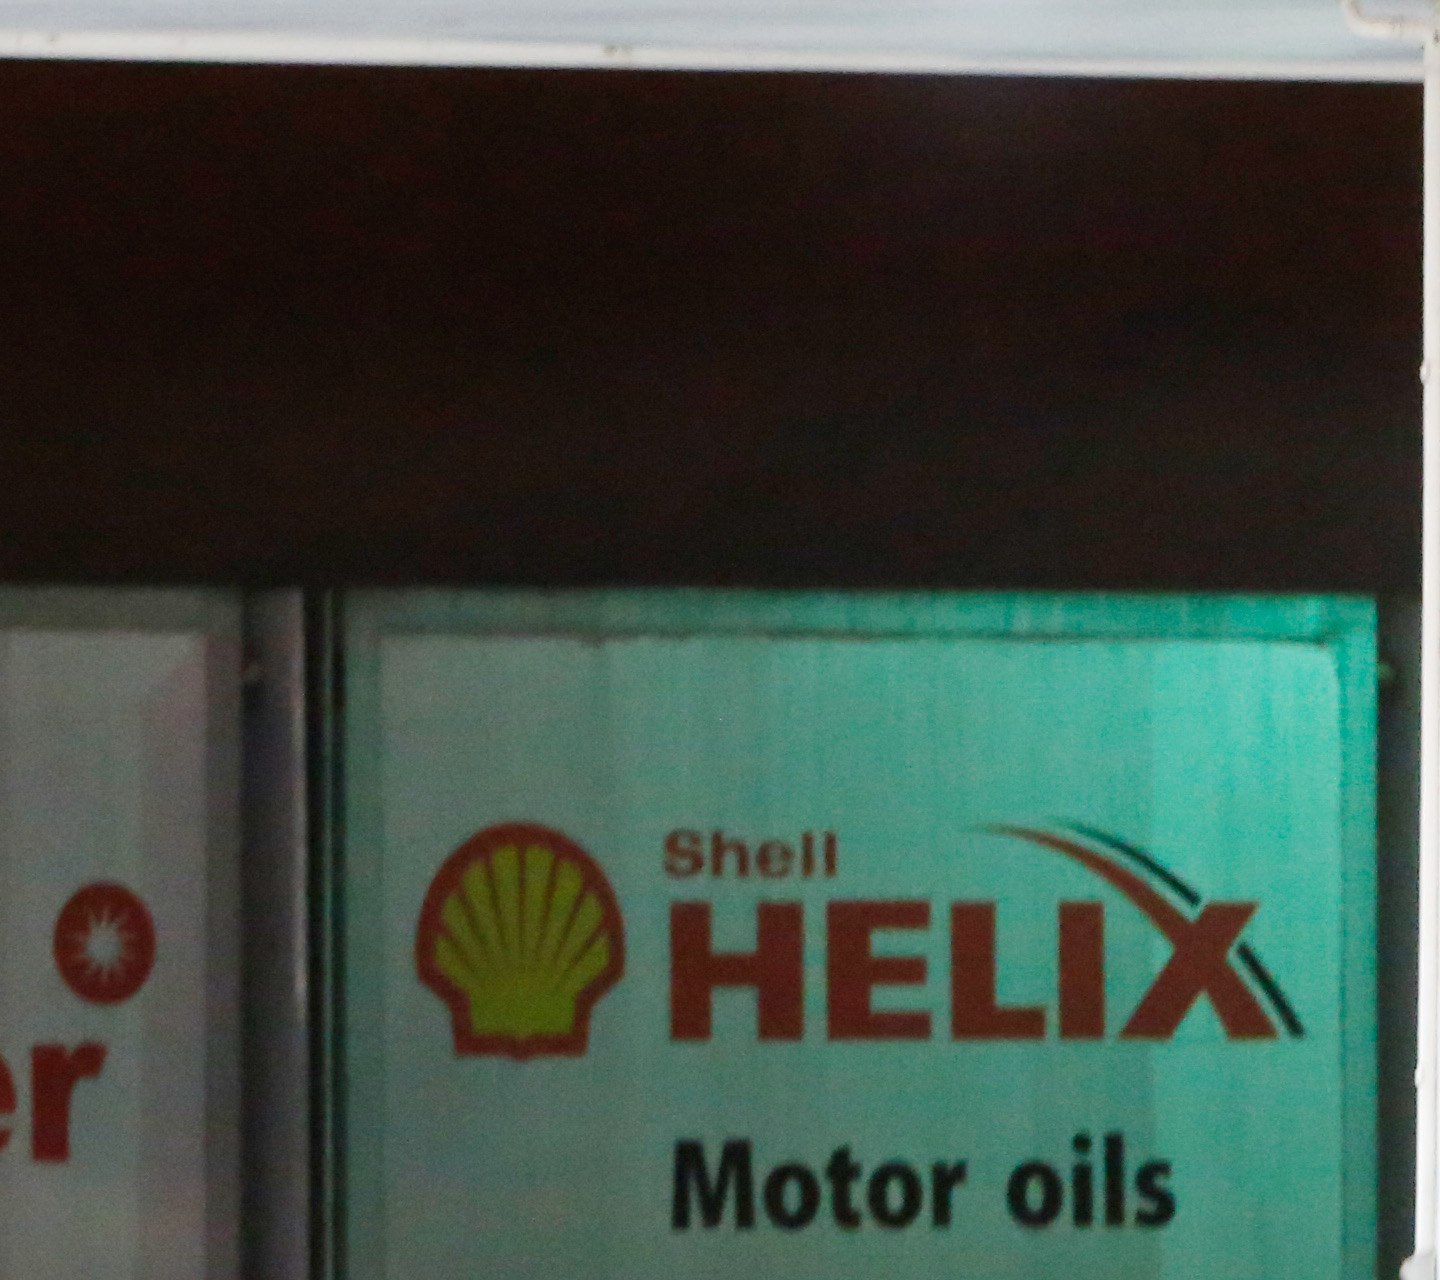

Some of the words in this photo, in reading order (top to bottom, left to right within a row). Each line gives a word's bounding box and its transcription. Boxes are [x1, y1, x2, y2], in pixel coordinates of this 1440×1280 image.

[662, 828, 839, 881] Shell
[668, 899, 1284, 1043] HELIX
[670, 1136, 967, 1233] Motor
[1005, 1132, 1178, 1233] oils
